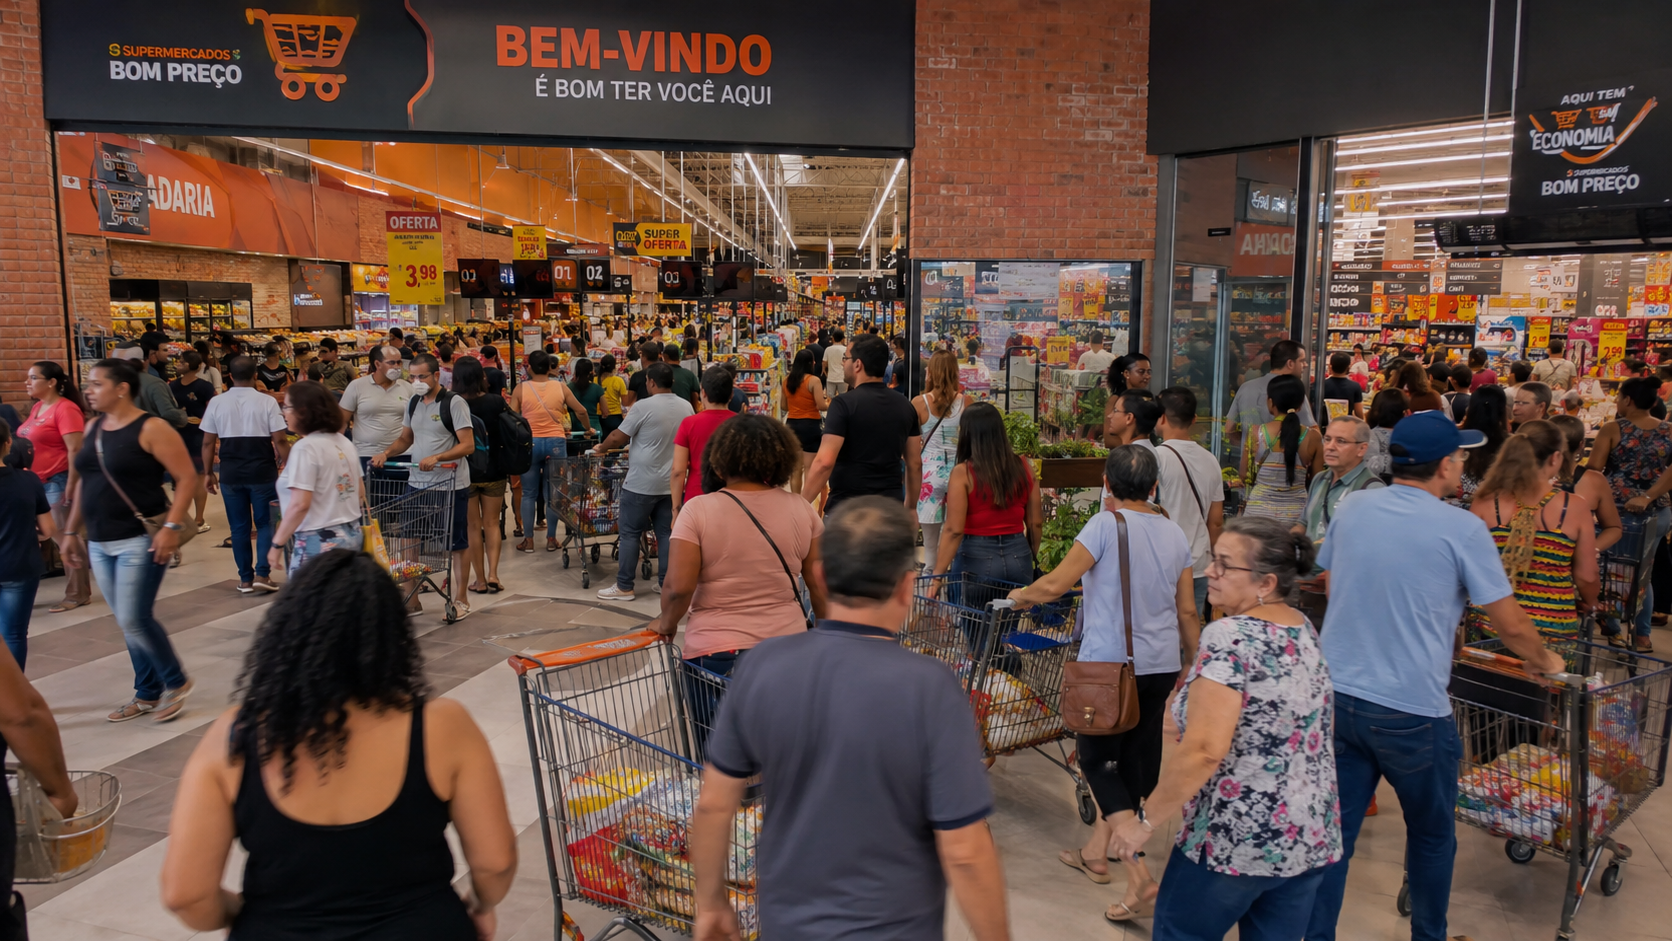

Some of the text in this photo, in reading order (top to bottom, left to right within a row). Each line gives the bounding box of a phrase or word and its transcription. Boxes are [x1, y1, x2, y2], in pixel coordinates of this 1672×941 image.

[123, 45, 231, 60] SUPERMERCADOS
[496, 25, 772, 76] BEM-VINDO
[109, 60, 242, 88] BOM PREÇO
[535, 73, 771, 106] É BOM TER VOCÊ AQUI
[1560, 87, 1626, 105] AQUI TEM
[1532, 125, 1614, 150] ECONOMIA
[1541, 174, 1640, 196] BOM PREÇO
[147, 174, 216, 218] ADARIA
[389, 215, 439, 229] OFERTA
[644, 228, 680, 239] SUPER
[643, 239, 688, 250] OFERTA
[586, 265, 603, 280] 02
